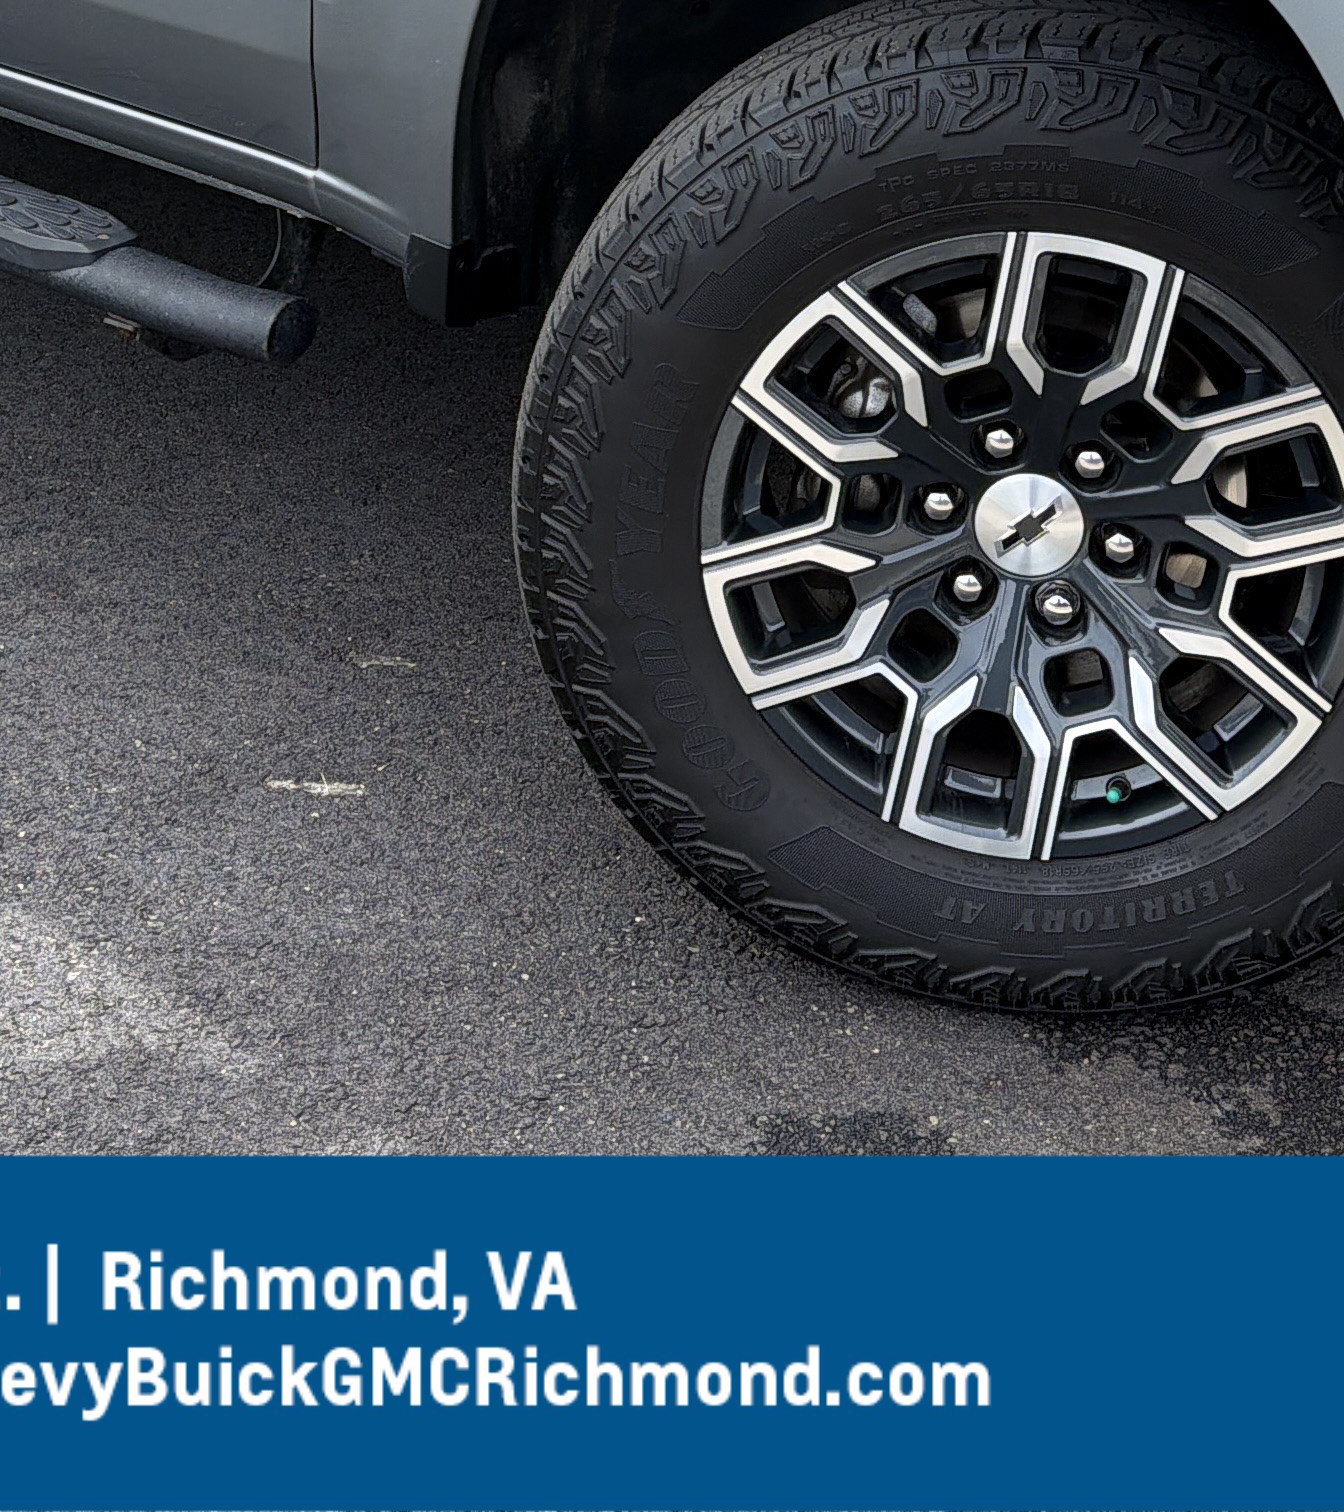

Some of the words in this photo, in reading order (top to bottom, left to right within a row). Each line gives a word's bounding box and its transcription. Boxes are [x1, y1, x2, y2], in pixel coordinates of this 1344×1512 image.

[926, 163, 978, 180] SPEC
[933, 897, 989, 925] AT
[1012, 869, 1246, 933] TERRITORY
